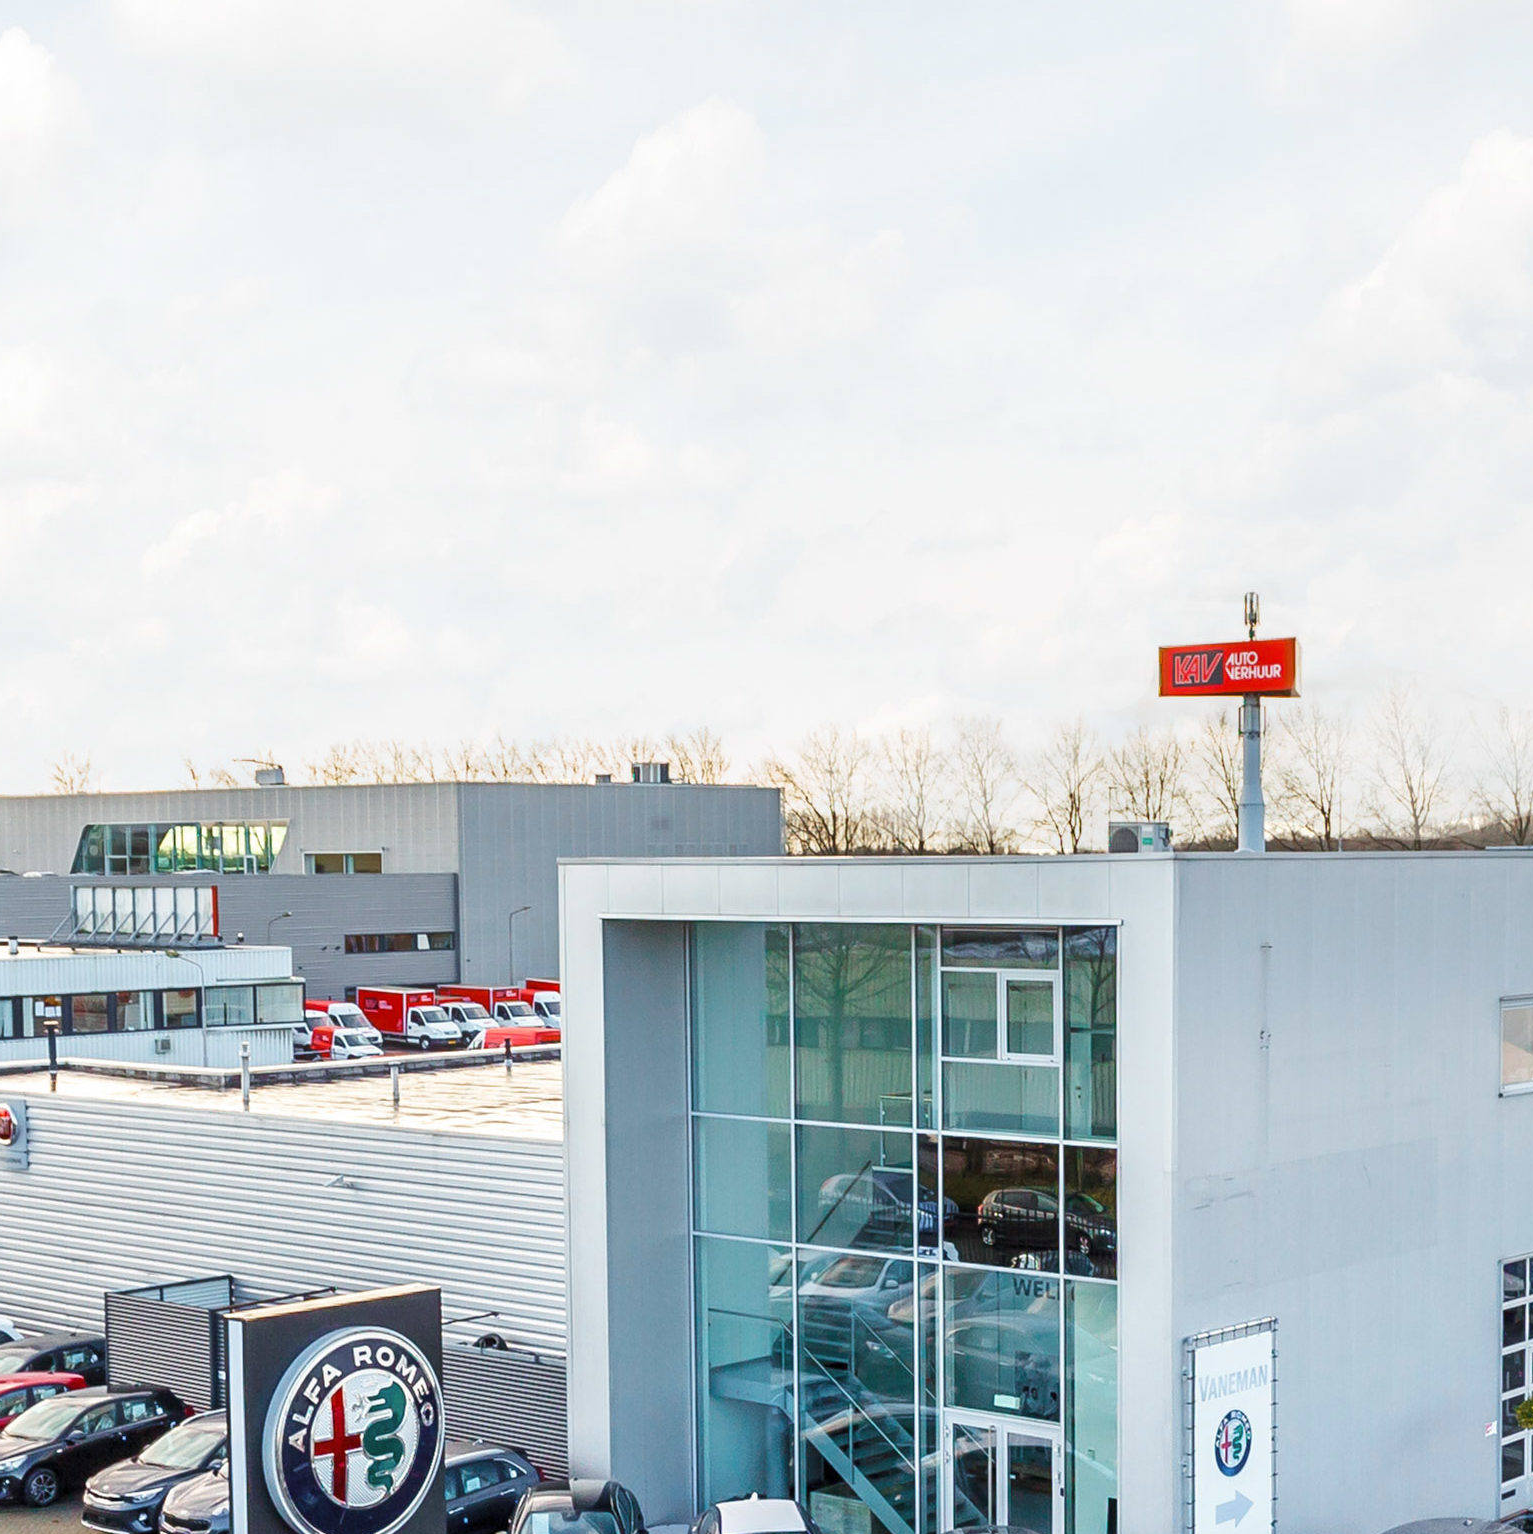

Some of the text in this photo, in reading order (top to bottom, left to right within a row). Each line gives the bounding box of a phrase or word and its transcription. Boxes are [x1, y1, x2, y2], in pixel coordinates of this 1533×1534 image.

[1225, 651, 1259, 667] AUTO
[1225, 664, 1282, 680] VERHUUR
[1198, 1364, 1268, 1402] VANEMAN
[288, 1344, 435, 1454] ALFA ROMEO
